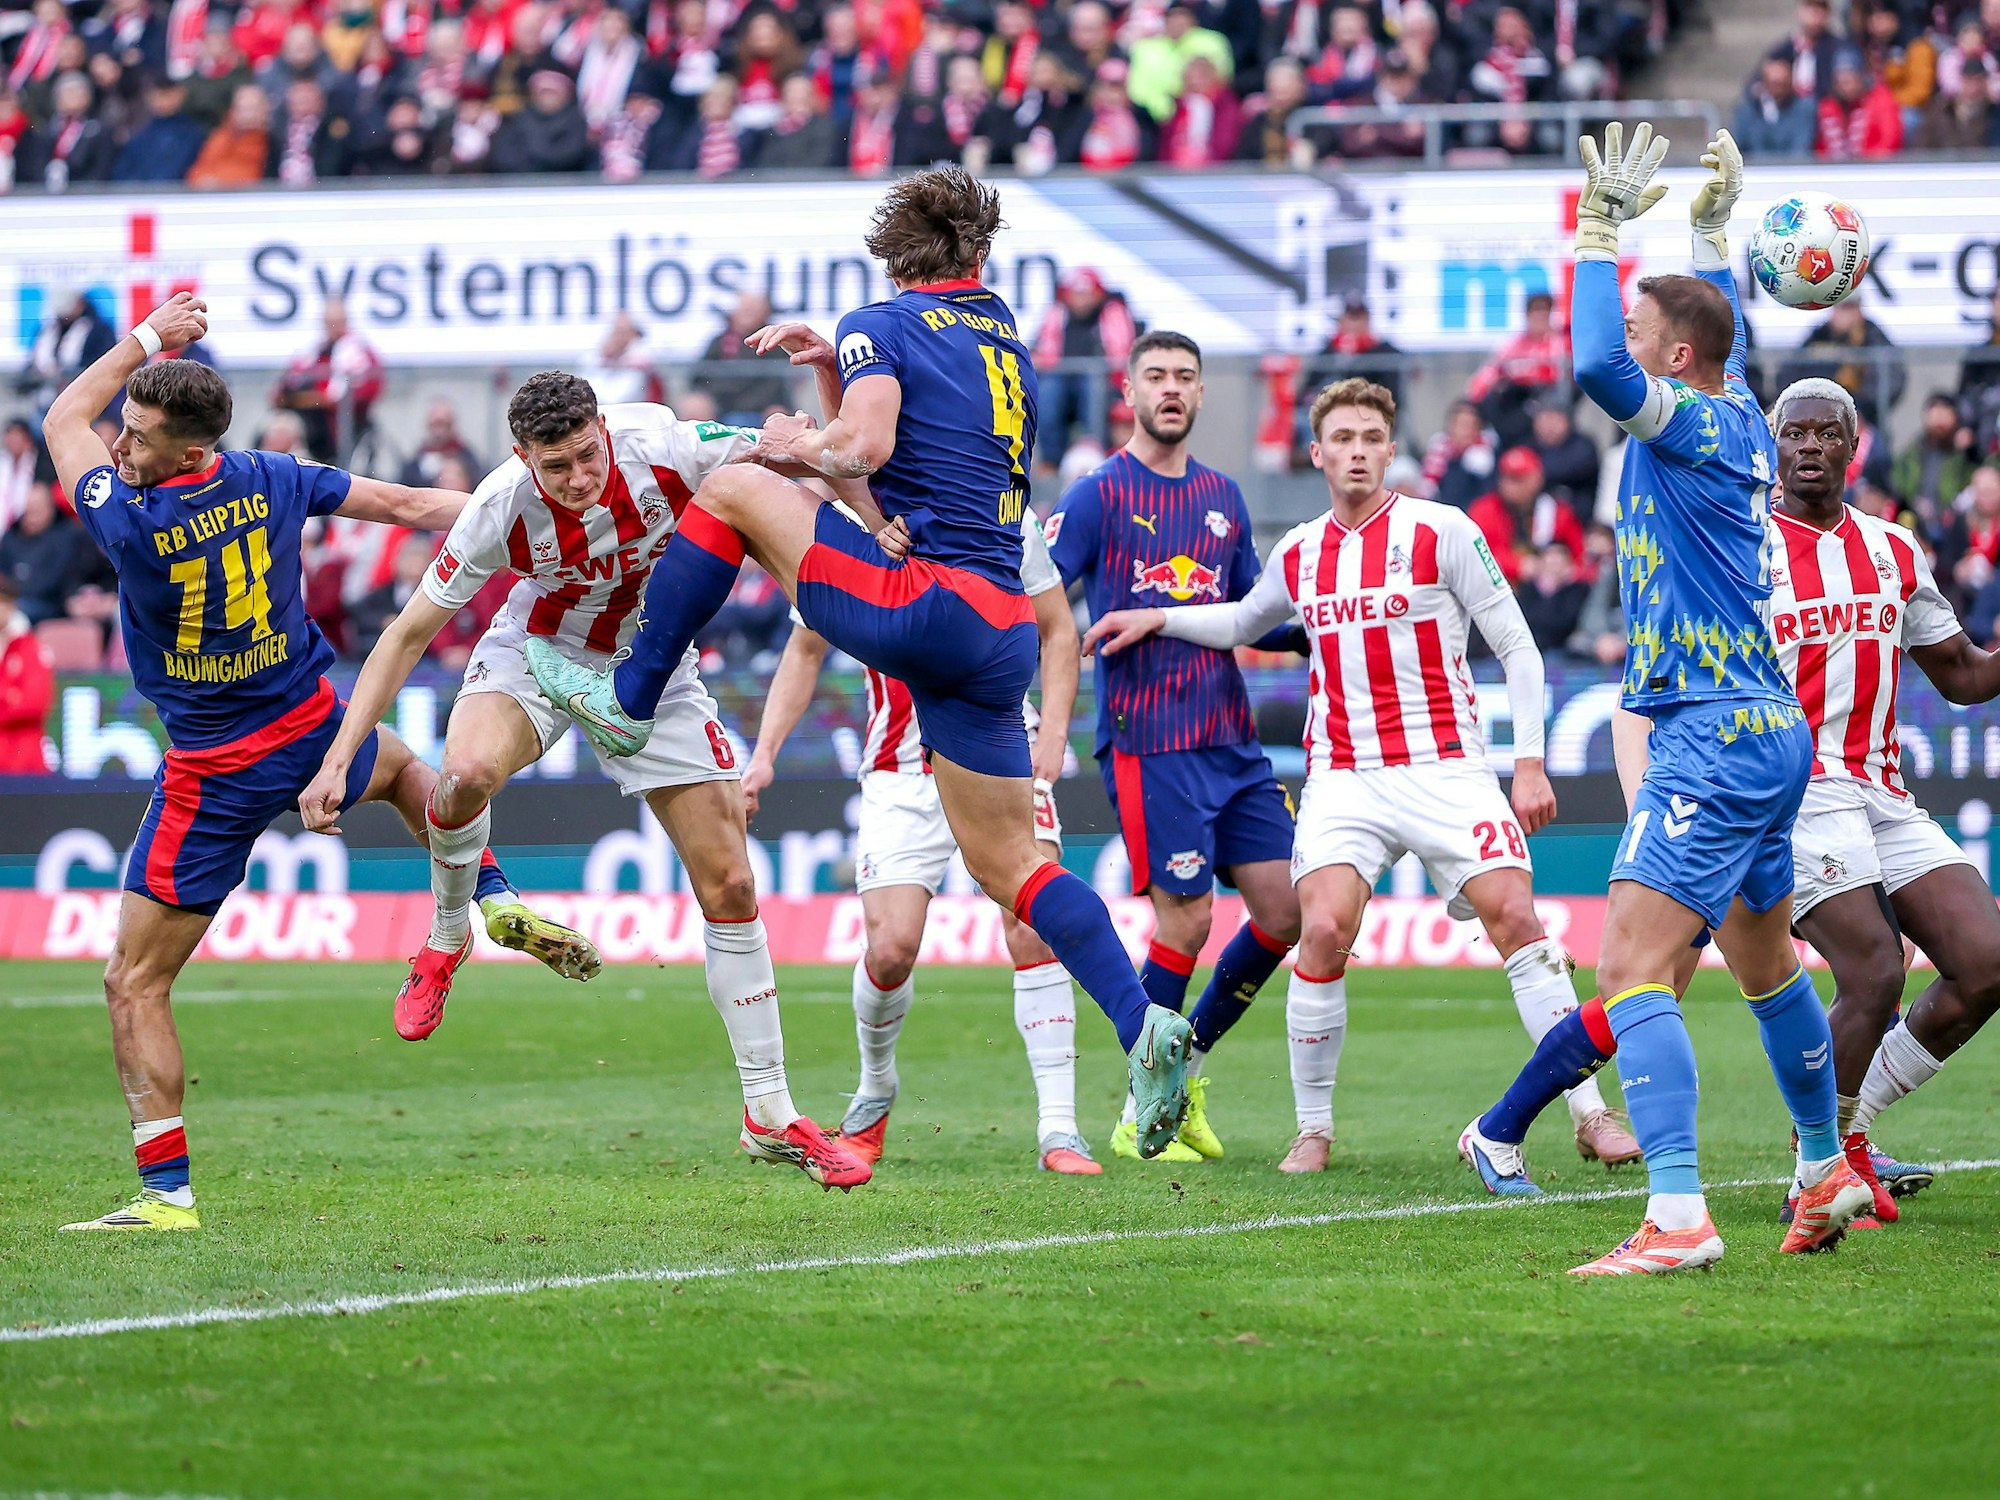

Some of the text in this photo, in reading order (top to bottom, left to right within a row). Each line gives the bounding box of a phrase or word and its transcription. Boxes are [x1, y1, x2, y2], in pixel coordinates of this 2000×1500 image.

[1828, 239, 1858, 302] DERBYSTAR
[920, 307, 1021, 343] RB LEIPZI
[978, 344, 1027, 475] 4
[1675, 386, 1698, 402] EVK
[153, 493, 269, 556] RB LEIPZIG
[553, 547, 639, 582] EWE
[169, 526, 274, 655] 14
[1303, 595, 1377, 630] REWE
[1773, 602, 1875, 645] REWE
[163, 632, 289, 683] BAUMGARTNER
[704, 720, 736, 770] 6
[1473, 820, 1526, 860] 28
[1624, 810, 1651, 863] 1
